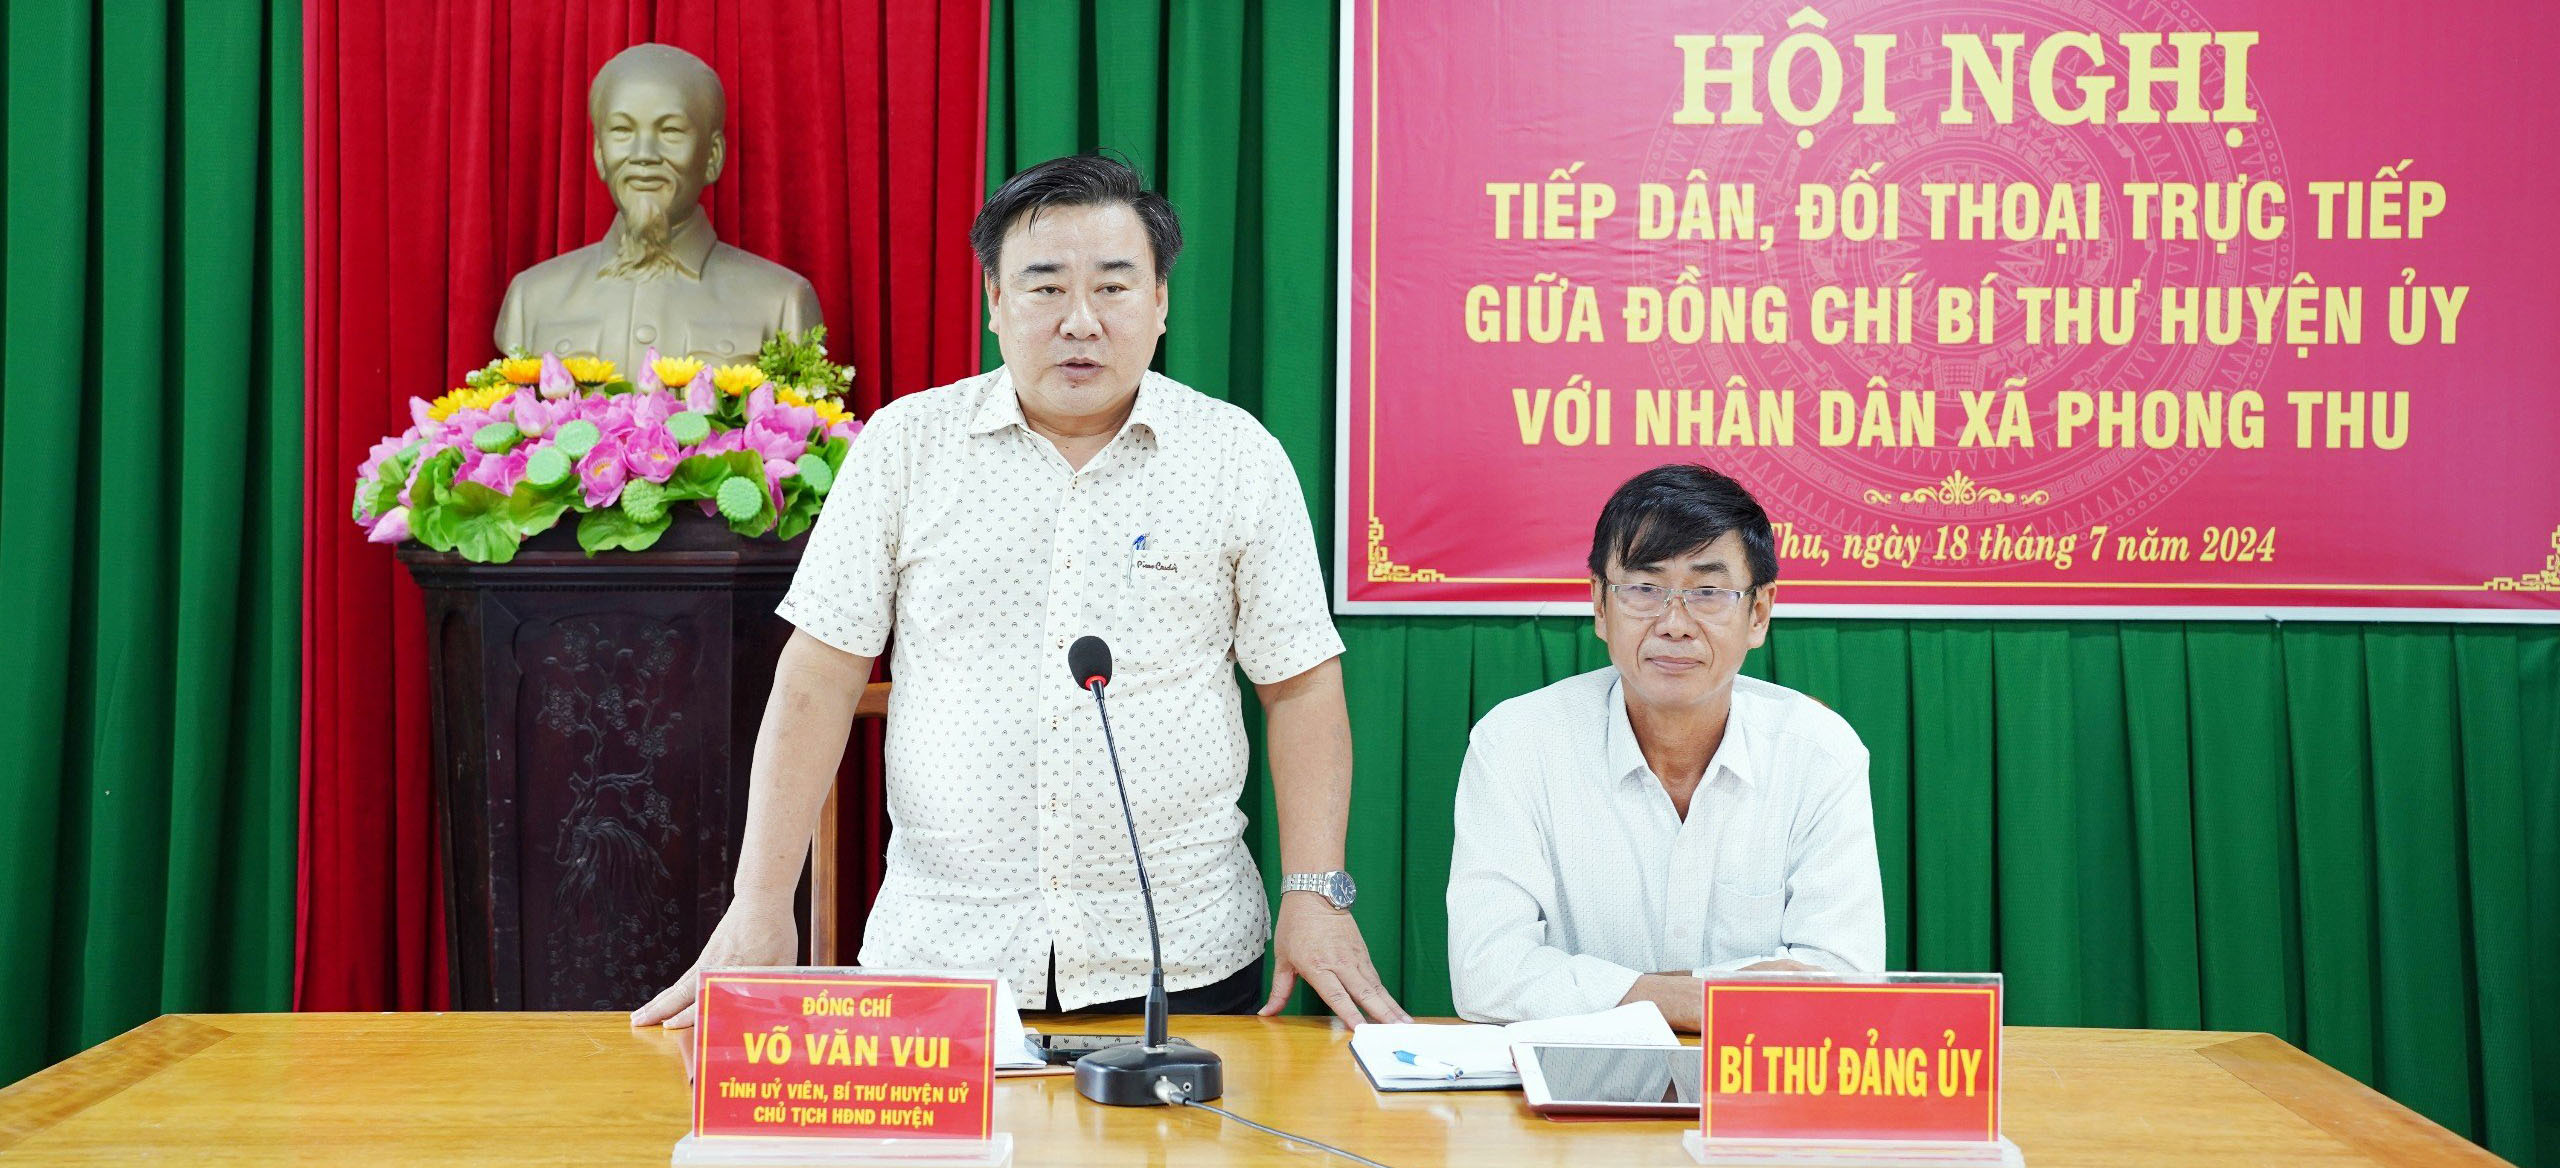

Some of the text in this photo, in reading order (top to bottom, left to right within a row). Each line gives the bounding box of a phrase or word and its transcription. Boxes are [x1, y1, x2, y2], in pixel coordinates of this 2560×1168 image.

[1674, 7, 2260, 148] HỘI NGHỊ
[1486, 158, 2447, 254] TIẾP DÂN, ĐỐI THOẠI TRỰC TIẾP
[1465, 265, 2470, 358] GIỮA ĐỒNG CHÍ BÍ THƯ HUYỆN ỦY
[1512, 375, 2410, 449] VỚI NHÂN DÂN XÃ PHONG THU
[1842, 524, 1922, 569] ngày
[1933, 524, 1970, 561] 18
[1979, 523, 2078, 571] tháng
[2090, 525, 2108, 561] 7
[2116, 527, 2189, 562] năm
[2199, 526, 2276, 562] 2024
[802, 989, 893, 1018] ĐỒNG CHÍ
[743, 1024, 951, 1069] VÕ VĂN VUI
[1719, 1027, 1983, 1098] BÍ THƯ ĐẢNG ỦY
[719, 1077, 970, 1105] TỈNH UỶ VIÊN, BÍ THƯ HUYỆN UỶ
[753, 1101, 935, 1129] CHỦ TỊCH HĐND HUYỆN
